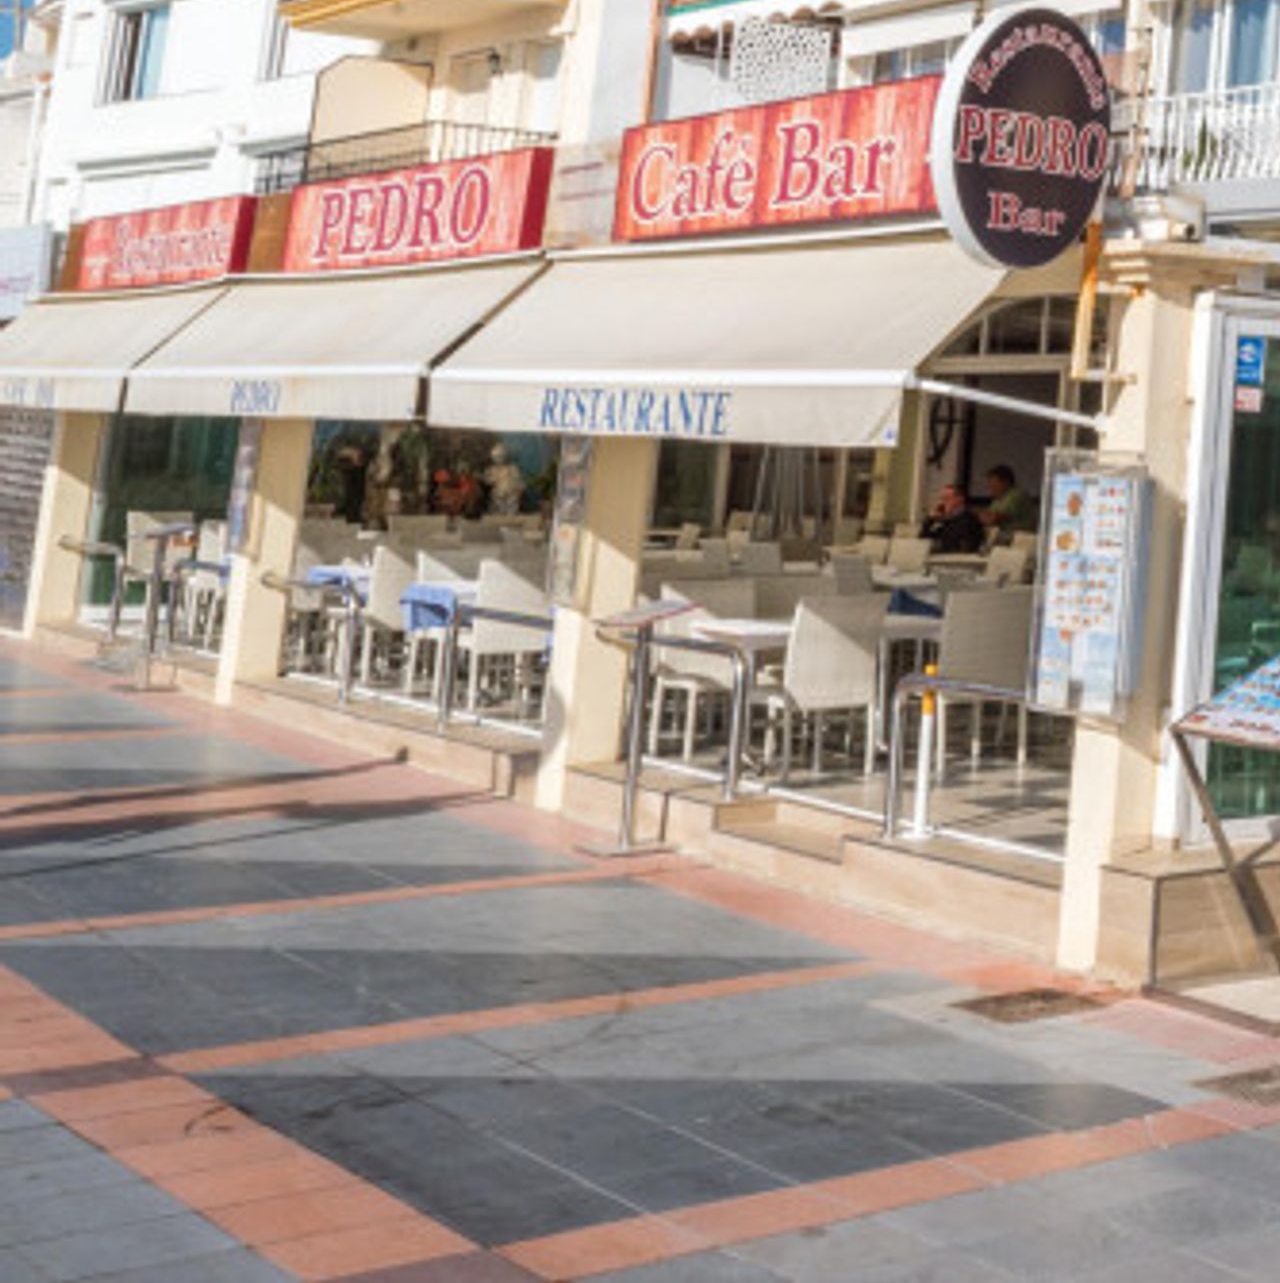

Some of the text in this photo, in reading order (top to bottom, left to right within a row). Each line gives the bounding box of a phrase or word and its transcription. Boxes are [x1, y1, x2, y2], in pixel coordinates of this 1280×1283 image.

[970, 23, 1106, 110] Restaurante
[772, 122, 897, 206] Bar
[957, 105, 1108, 182] PEDRO
[312, 166, 490, 259] PEDRO
[987, 191, 1065, 236] Bar
[539, 387, 732, 436] RESTAURANTE
